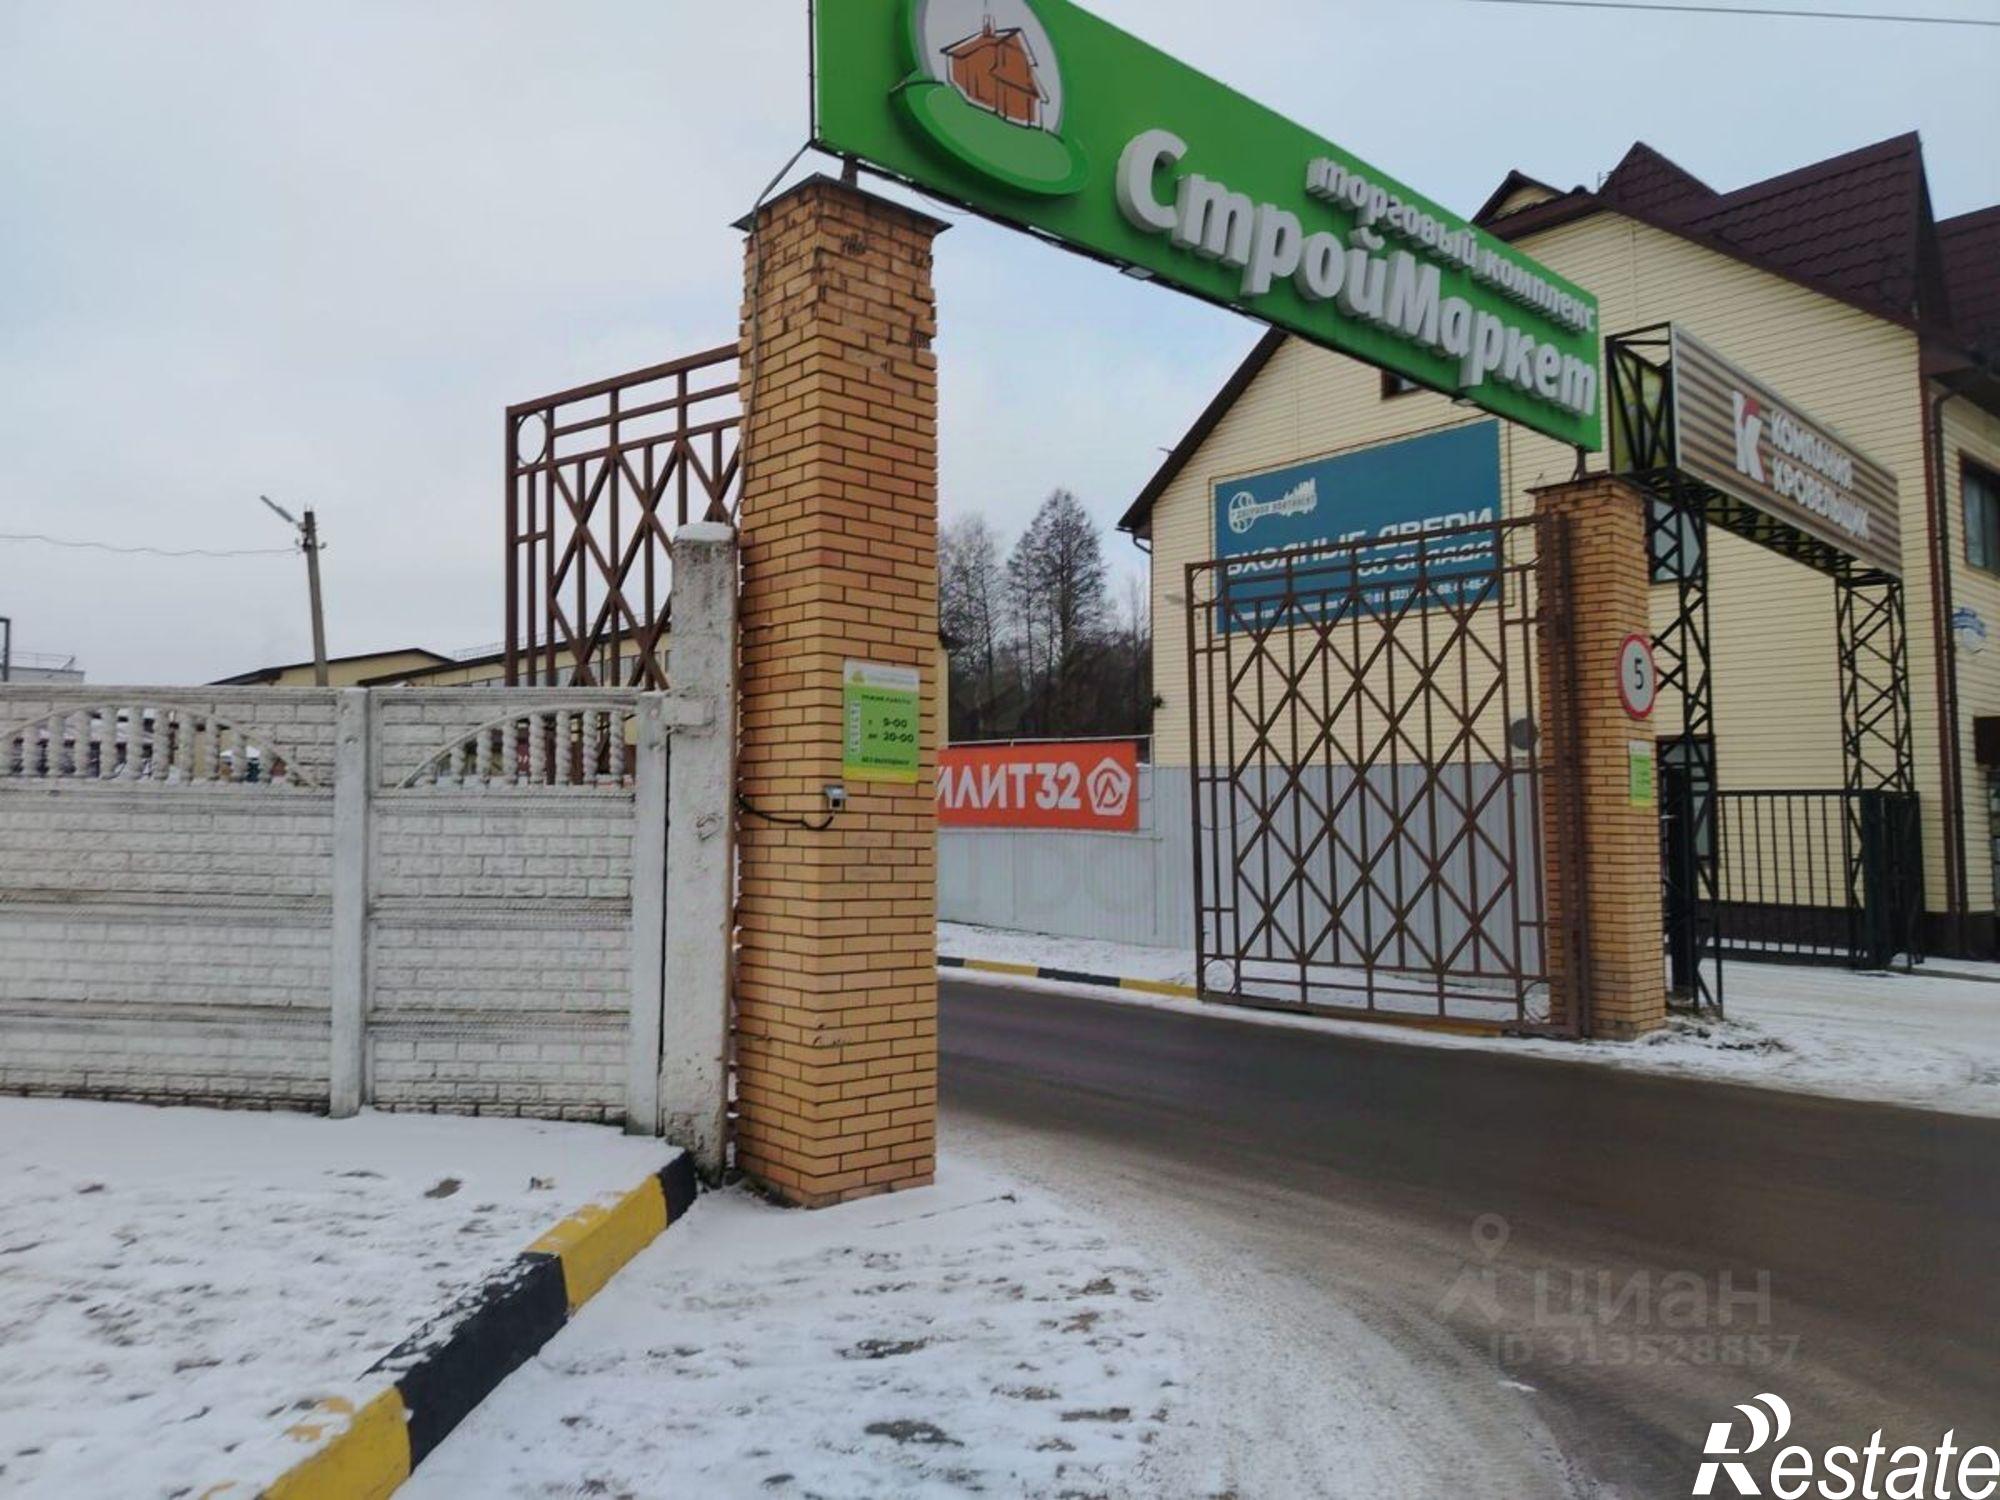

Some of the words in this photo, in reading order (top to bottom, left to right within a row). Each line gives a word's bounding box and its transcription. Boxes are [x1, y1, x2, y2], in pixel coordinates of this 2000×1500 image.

[1116, 129, 1595, 416] СтройМаркет
[1306, 157, 1478, 272] торговый
[1479, 245, 1595, 334] комплекс
[1633, 658, 1645, 690] 5
